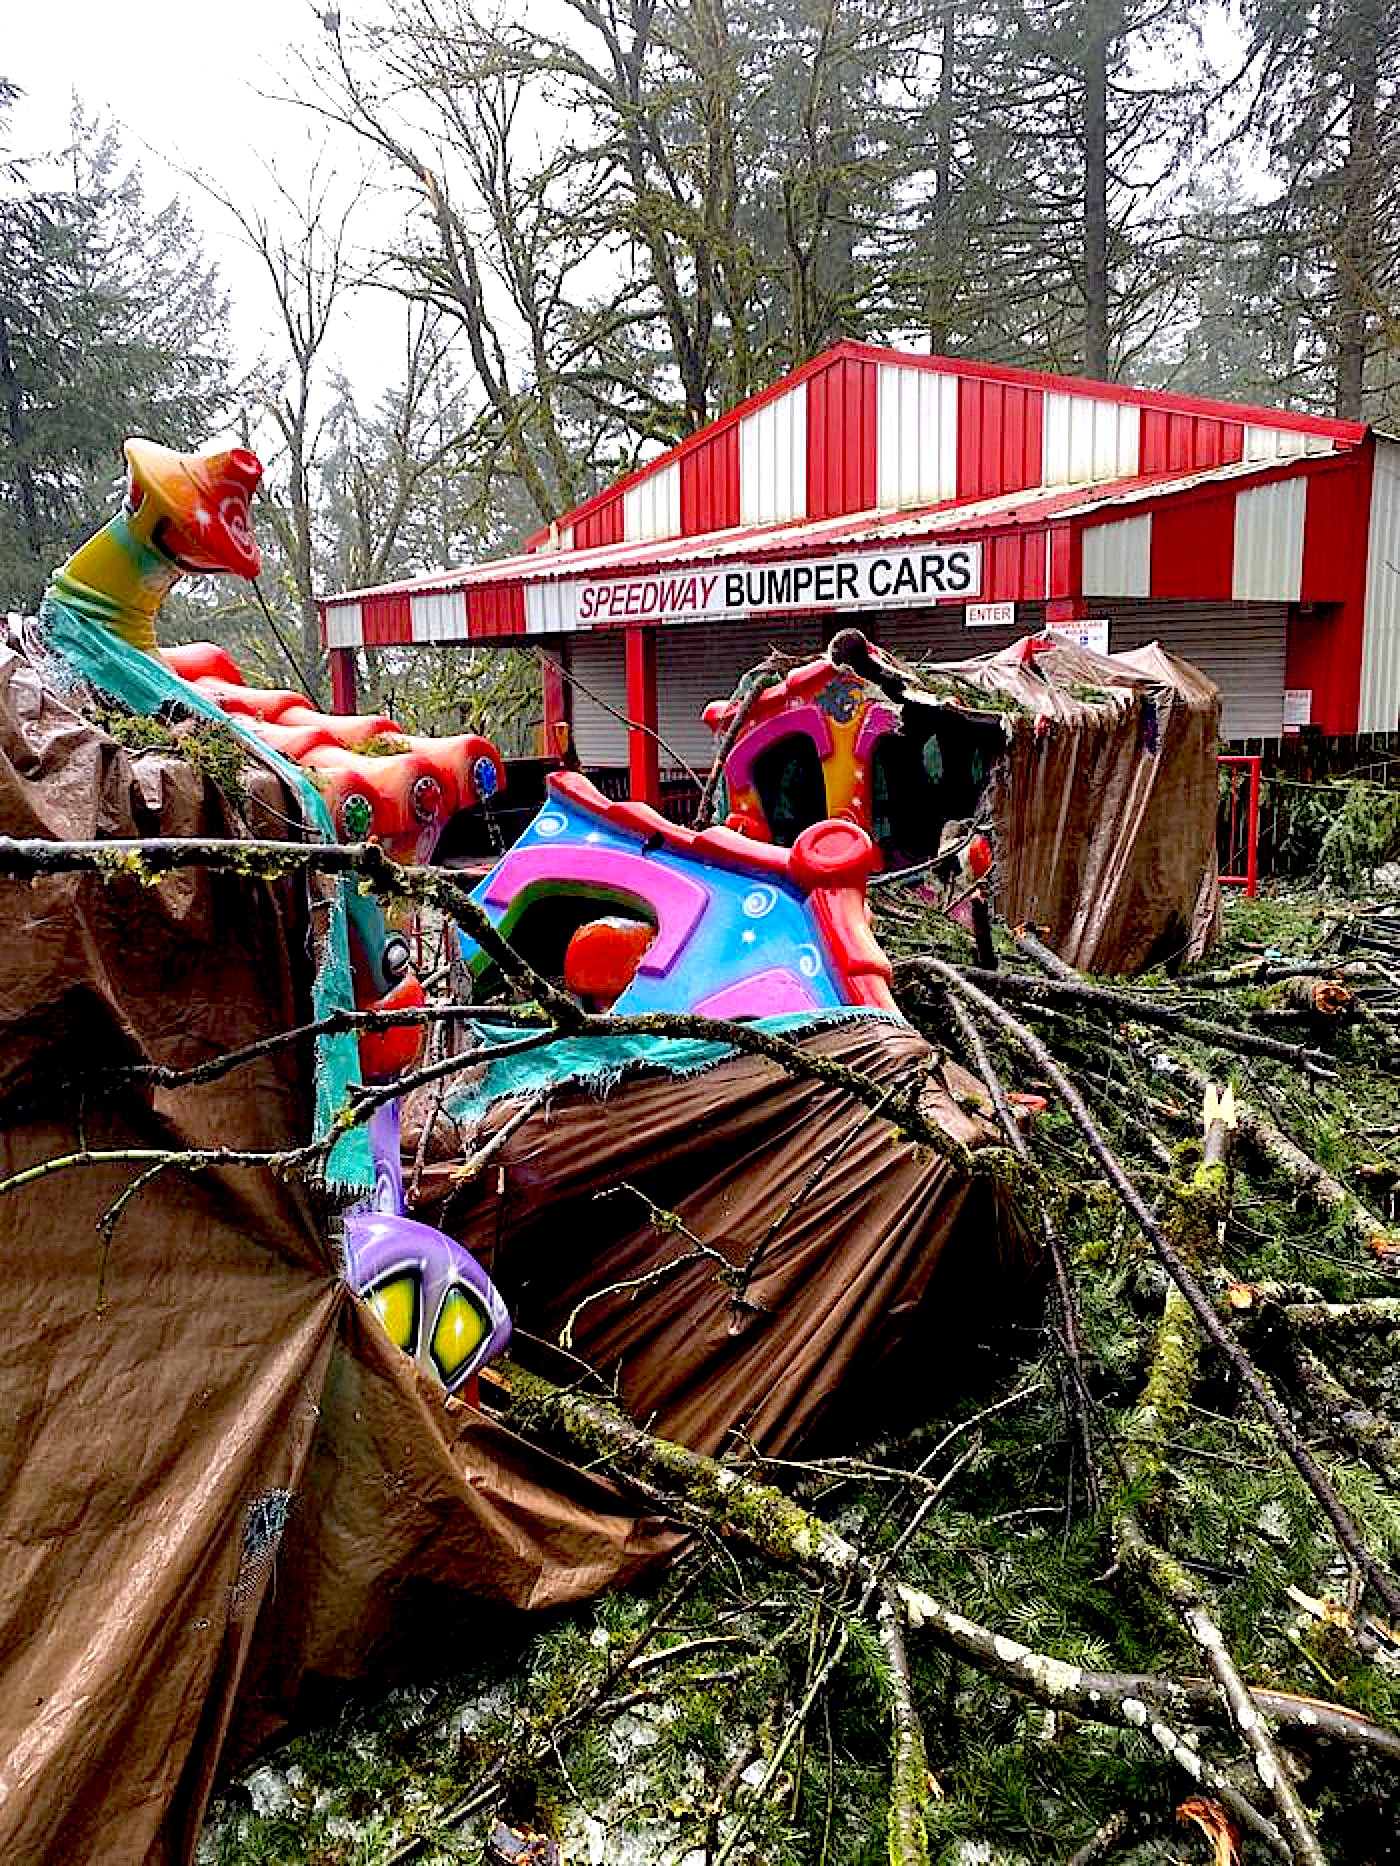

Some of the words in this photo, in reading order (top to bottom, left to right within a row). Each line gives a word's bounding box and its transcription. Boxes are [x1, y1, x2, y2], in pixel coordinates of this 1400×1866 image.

[579, 575, 718, 618] SPEEDWAY
[725, 562, 858, 607] BUMPER
[868, 551, 971, 596] CARS
[969, 607, 1011, 622] ENTER
